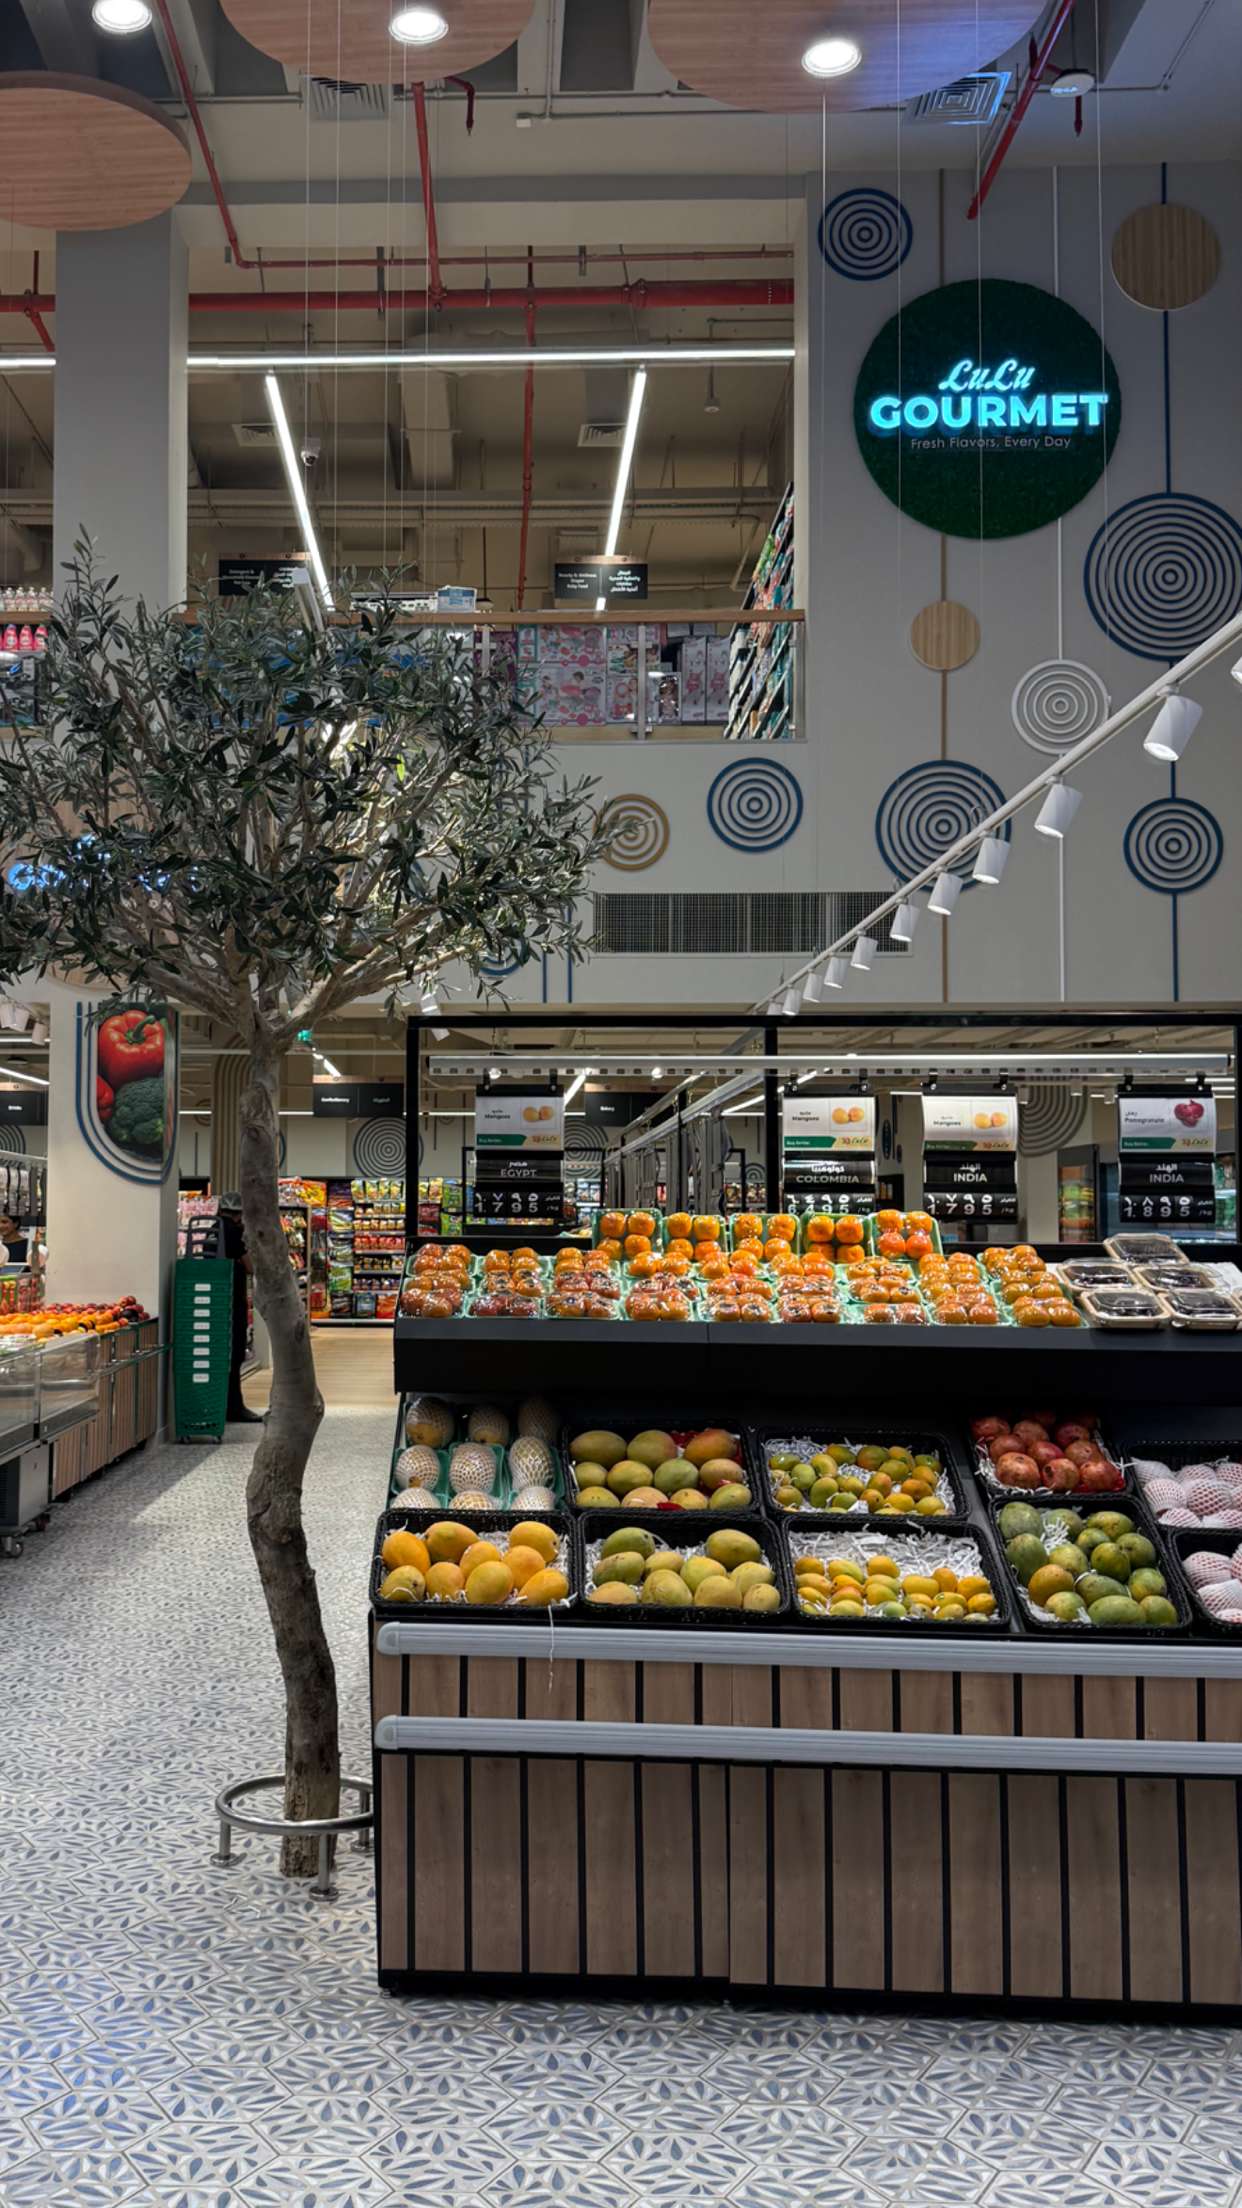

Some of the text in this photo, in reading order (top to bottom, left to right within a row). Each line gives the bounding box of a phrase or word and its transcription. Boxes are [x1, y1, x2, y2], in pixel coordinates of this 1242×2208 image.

[938, 359, 1036, 391] LuLu
[869, 394, 1109, 429] GOURMET
[911, 436, 1071, 449] Fresh Flavors, Every Day
[501, 1169, 536, 1177] EGYPT
[959, 1163, 981, 1173] الهند
[1156, 1163, 1178, 1173] الهند
[796, 1175, 859, 1183] COLOMBIA
[953, 1173, 988, 1182] INDIA
[1150, 1174, 1184, 1183] INDIA
